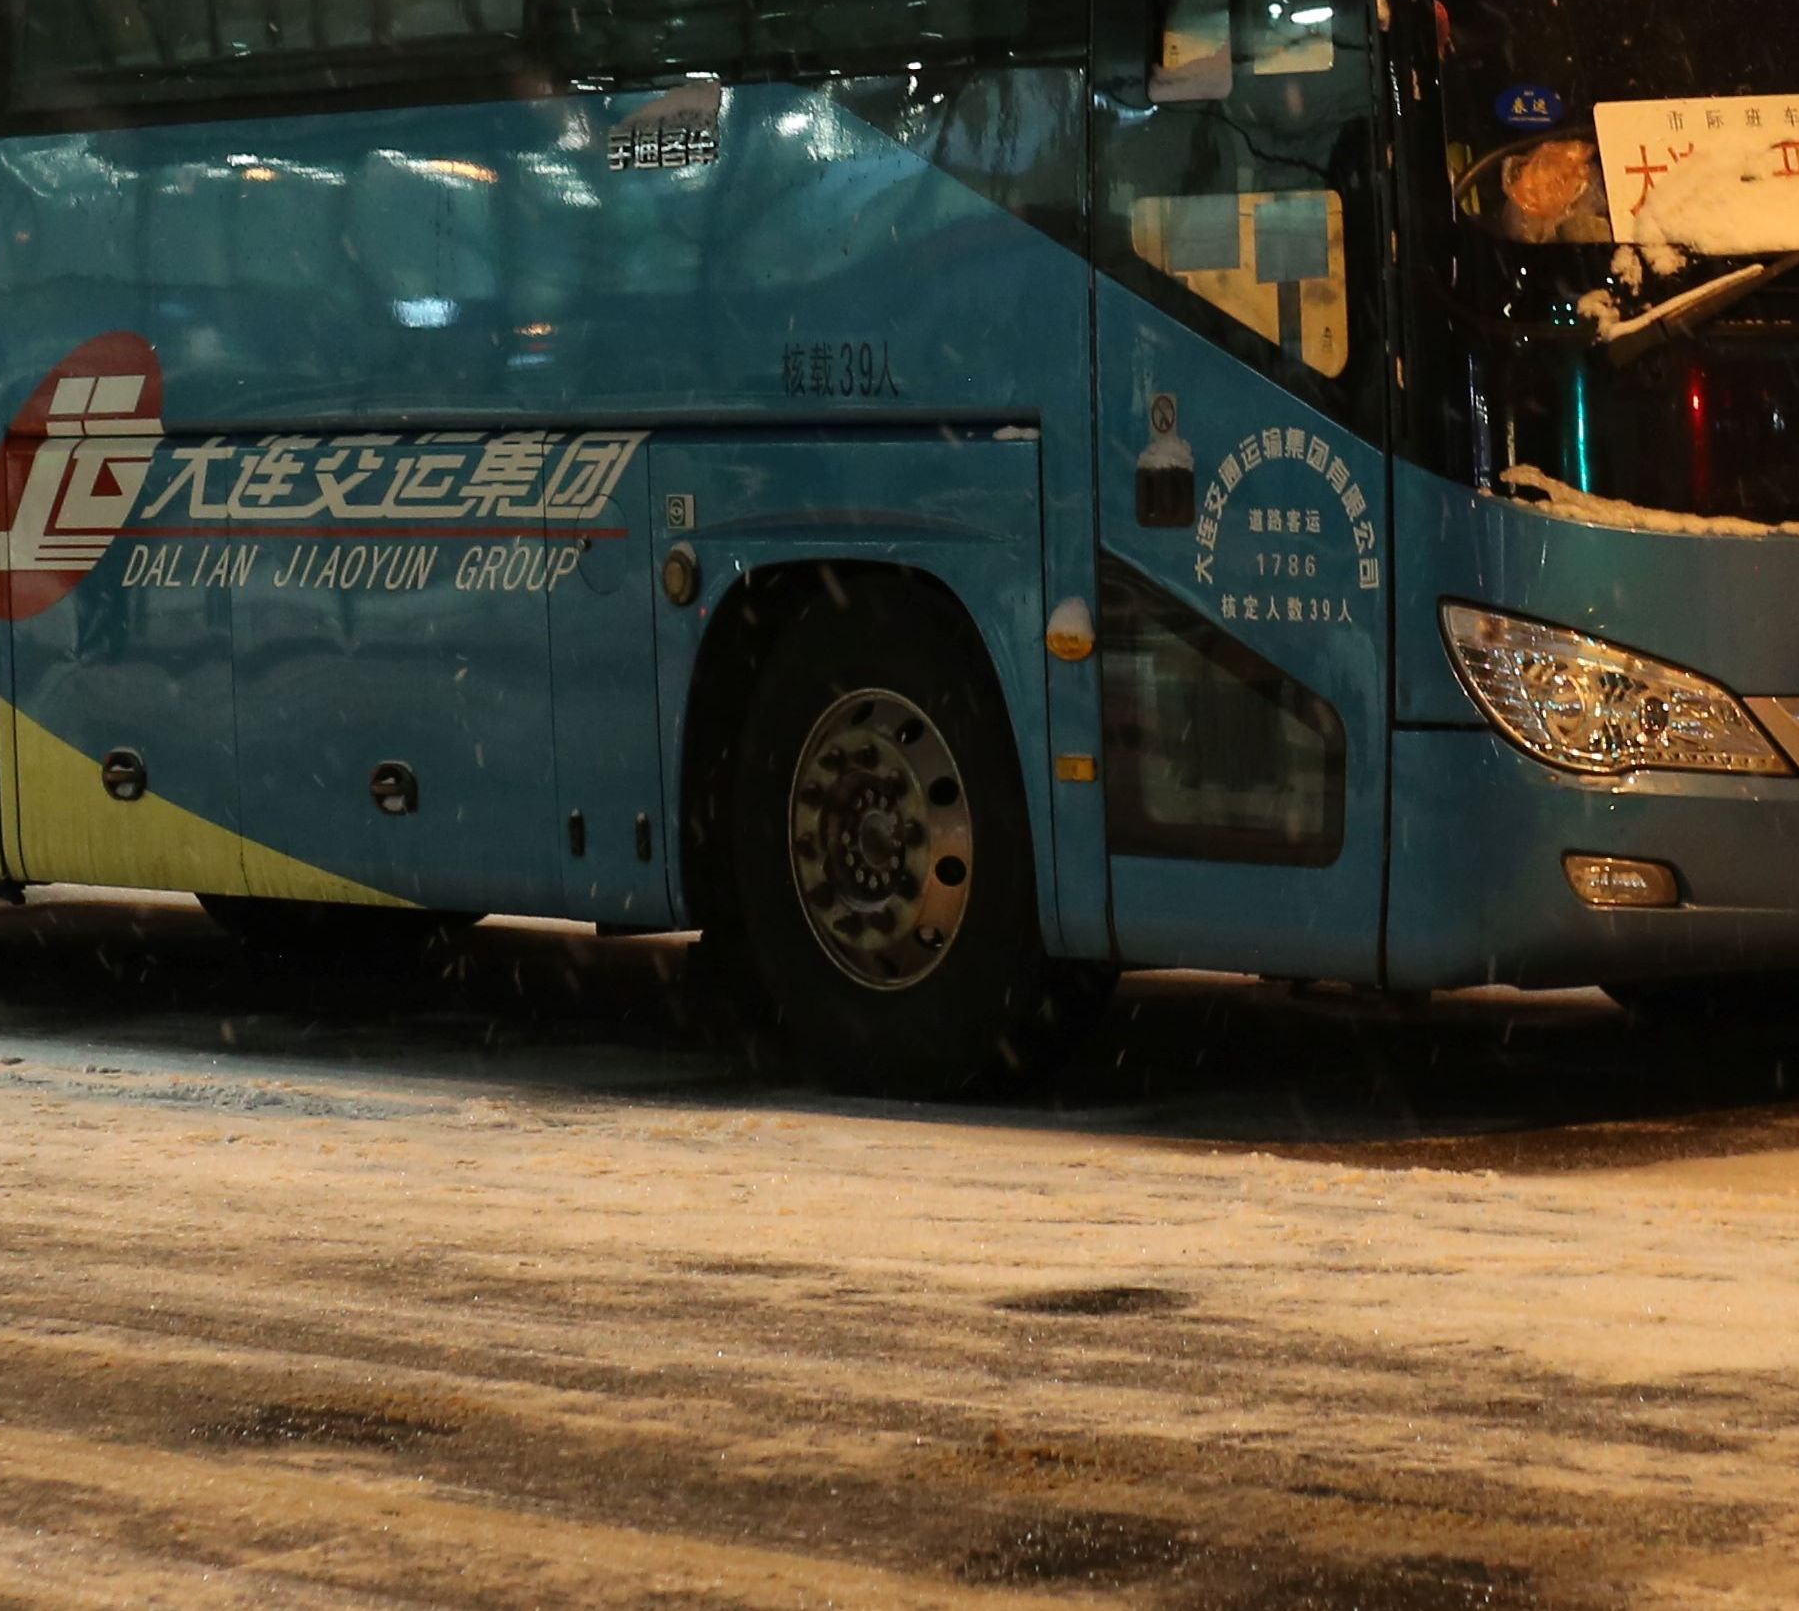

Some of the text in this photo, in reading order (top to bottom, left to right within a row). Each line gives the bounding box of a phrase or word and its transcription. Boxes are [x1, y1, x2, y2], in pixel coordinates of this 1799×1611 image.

[782, 340, 899, 398] 核载39人
[140, 430, 652, 521] 大连交运集团
[1193, 426, 1381, 590] 大连交通运输集团有限公司
[1249, 507, 1321, 535] 道路客运
[121, 543, 581, 592] DALIAN JIAOYUN GROUP
[1256, 552, 1318, 578] 1786
[1221, 592, 1353, 623] 核定人数39人
